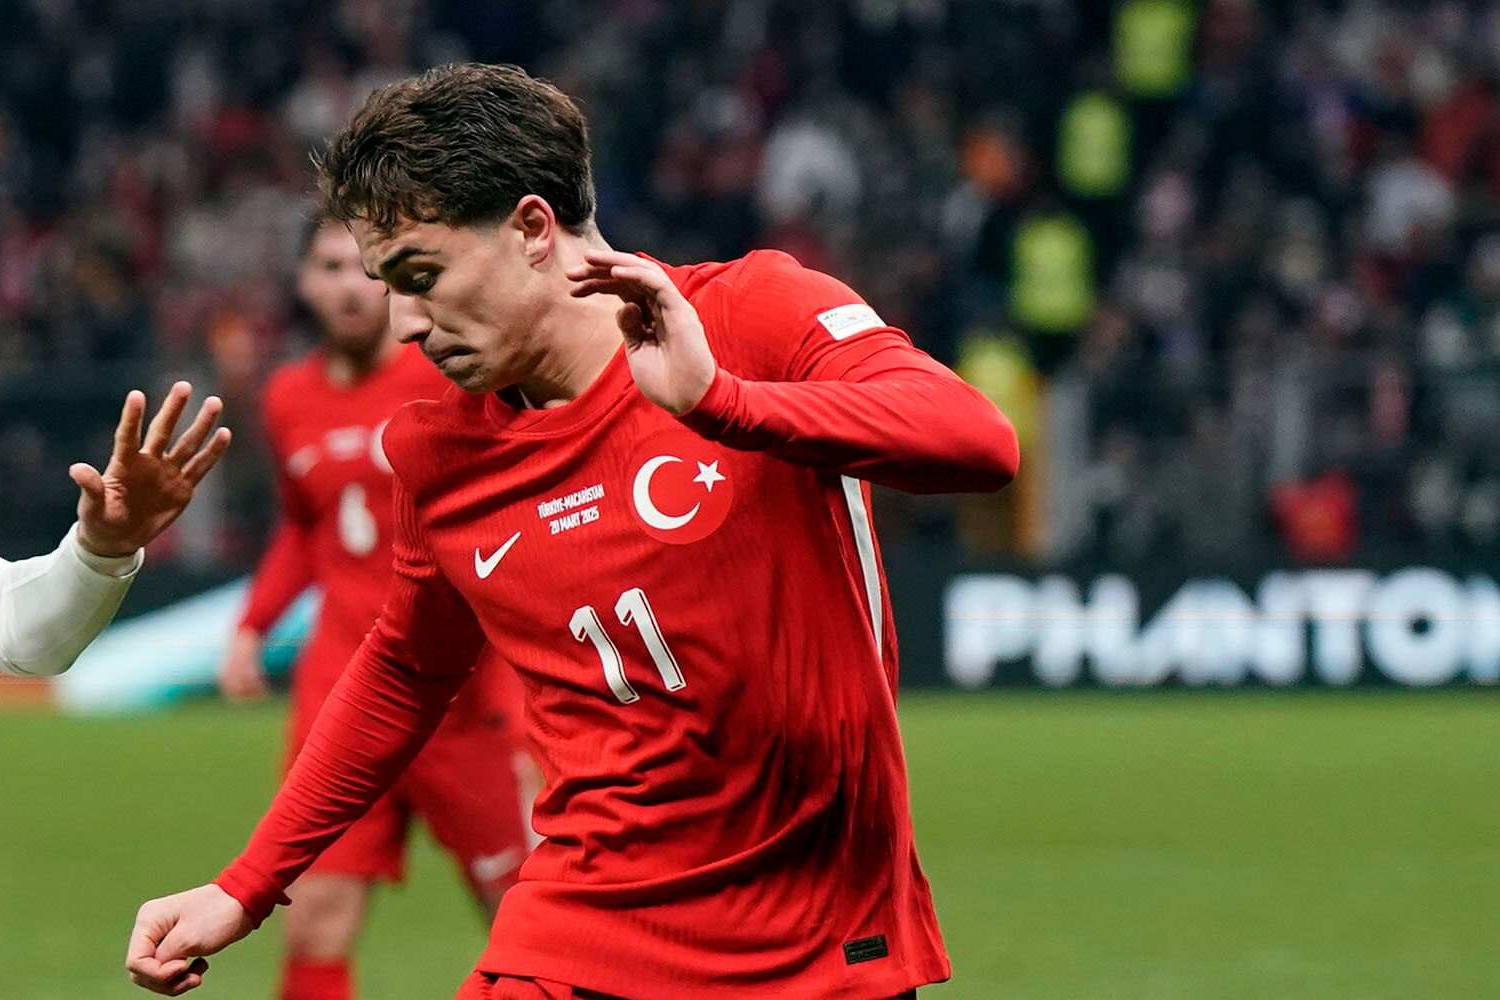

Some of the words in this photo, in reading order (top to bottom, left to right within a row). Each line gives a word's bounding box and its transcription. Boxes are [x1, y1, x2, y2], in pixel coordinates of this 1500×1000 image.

[549, 519, 560, 535] 20
[560, 512, 581, 531] MART
[581, 505, 600, 525] 2025
[568, 587, 687, 704] 11
[943, 567, 1500, 686] PHANTO
